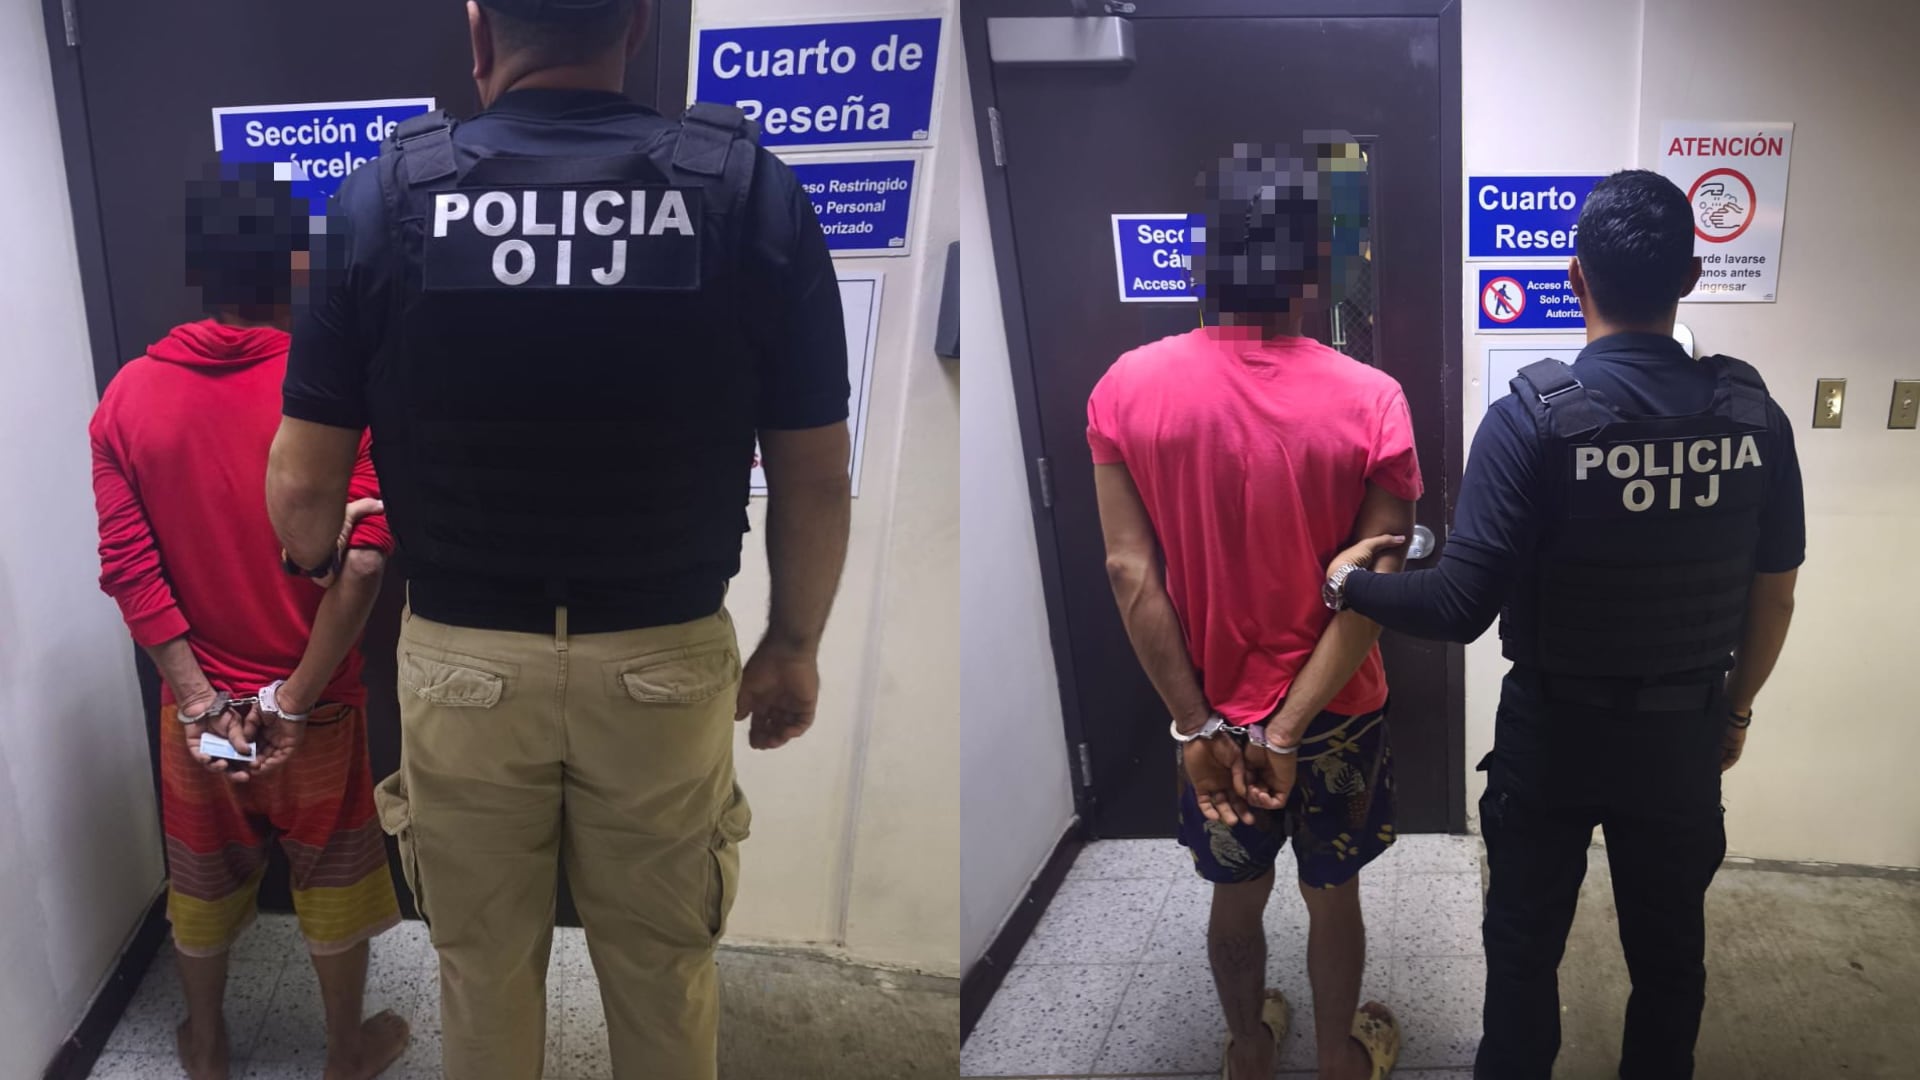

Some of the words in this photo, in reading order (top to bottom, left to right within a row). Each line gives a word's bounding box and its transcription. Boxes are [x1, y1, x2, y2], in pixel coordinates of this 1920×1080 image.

[712, 38, 857, 79] Cuarto
[871, 34, 923, 72] de
[735, 95, 891, 134] Reseña
[245, 117, 356, 147] Sección
[1667, 132, 1783, 156] ATENCIÓN
[829, 177, 908, 194] Restringido
[1478, 184, 1576, 210] Cuarto
[433, 190, 694, 237] POLICIA
[826, 199, 886, 214] Personal
[820, 221, 873, 235] orizado
[1702, 253, 1721, 264] rde
[1724, 253, 1766, 264] lavarse
[1700, 269, 1727, 278] anos
[1730, 269, 1761, 278] antes
[1133, 277, 1186, 290] Acceso
[1527, 280, 1561, 290] Acceso
[1699, 281, 1746, 293] ingresar
[1539, 295, 1560, 304] Solo
[1545, 308, 1585, 318] Autoriza
[1575, 435, 1762, 480] POLICIA
